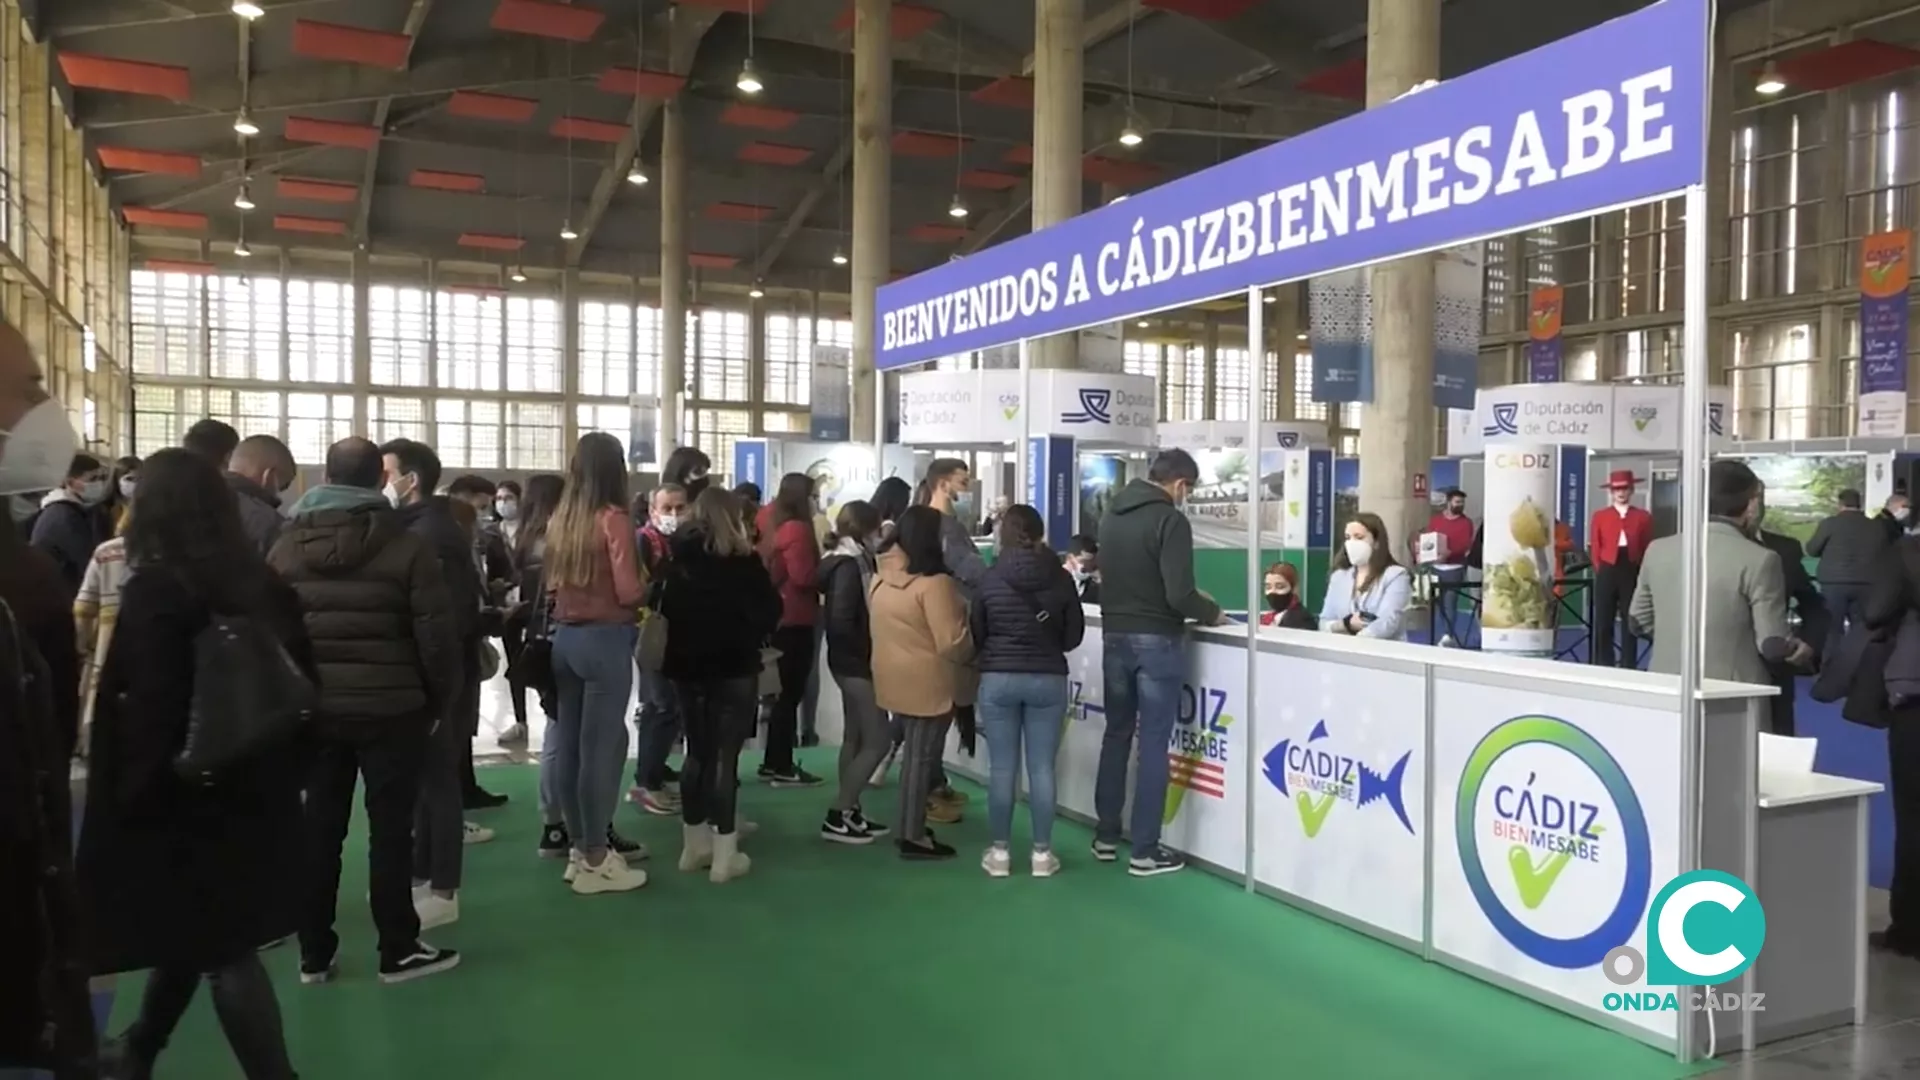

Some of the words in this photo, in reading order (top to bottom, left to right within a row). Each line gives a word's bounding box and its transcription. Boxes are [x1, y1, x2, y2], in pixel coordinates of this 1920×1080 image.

[882, 260, 1060, 352] BIENVENIDOS
[1063, 252, 1092, 307] A
[1096, 65, 1675, 298] CÁDIZBIENMESABE
[1524, 424, 1541, 436] de
[1547, 420, 1589, 435] Cádiz
[1525, 400, 1604, 417] Diputación
[1177, 683, 1228, 735] DIZ
[1494, 771, 1600, 842] CÁDIZ
[1493, 819, 1600, 863] BIENMESABE
